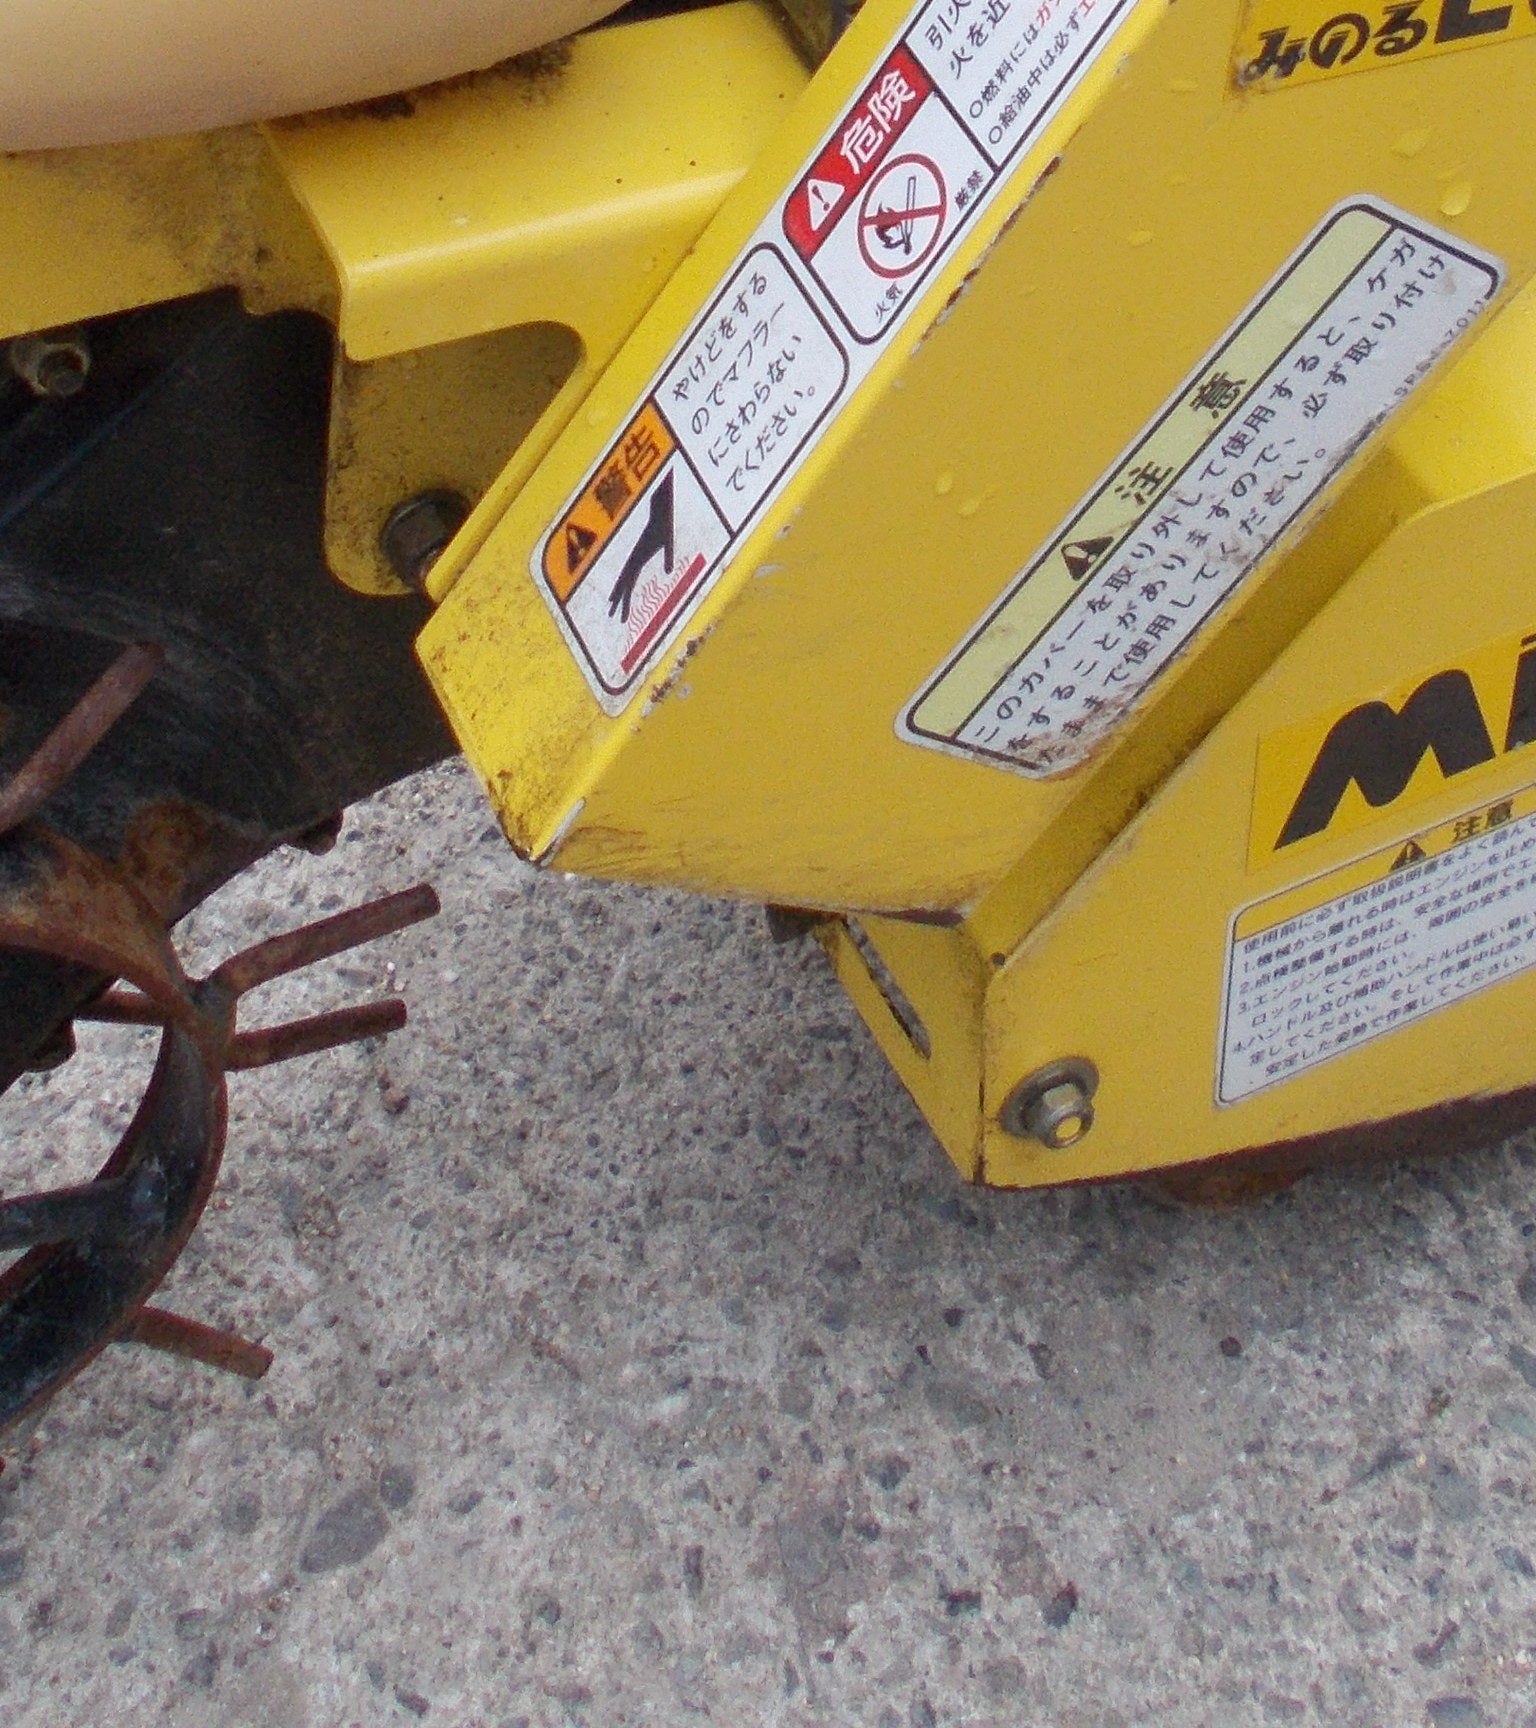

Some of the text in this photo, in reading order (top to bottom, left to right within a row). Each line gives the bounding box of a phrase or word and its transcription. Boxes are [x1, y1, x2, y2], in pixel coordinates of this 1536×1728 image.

[835, 62, 917, 178] 危険
[672, 272, 766, 400] やけどをする
[691, 302, 784, 435] のでマフラー
[707, 335, 801, 466] にさわらない
[725, 386, 814, 491] でください。
[594, 420, 661, 524] 警告
[1451, 797, 1514, 845] 注意
